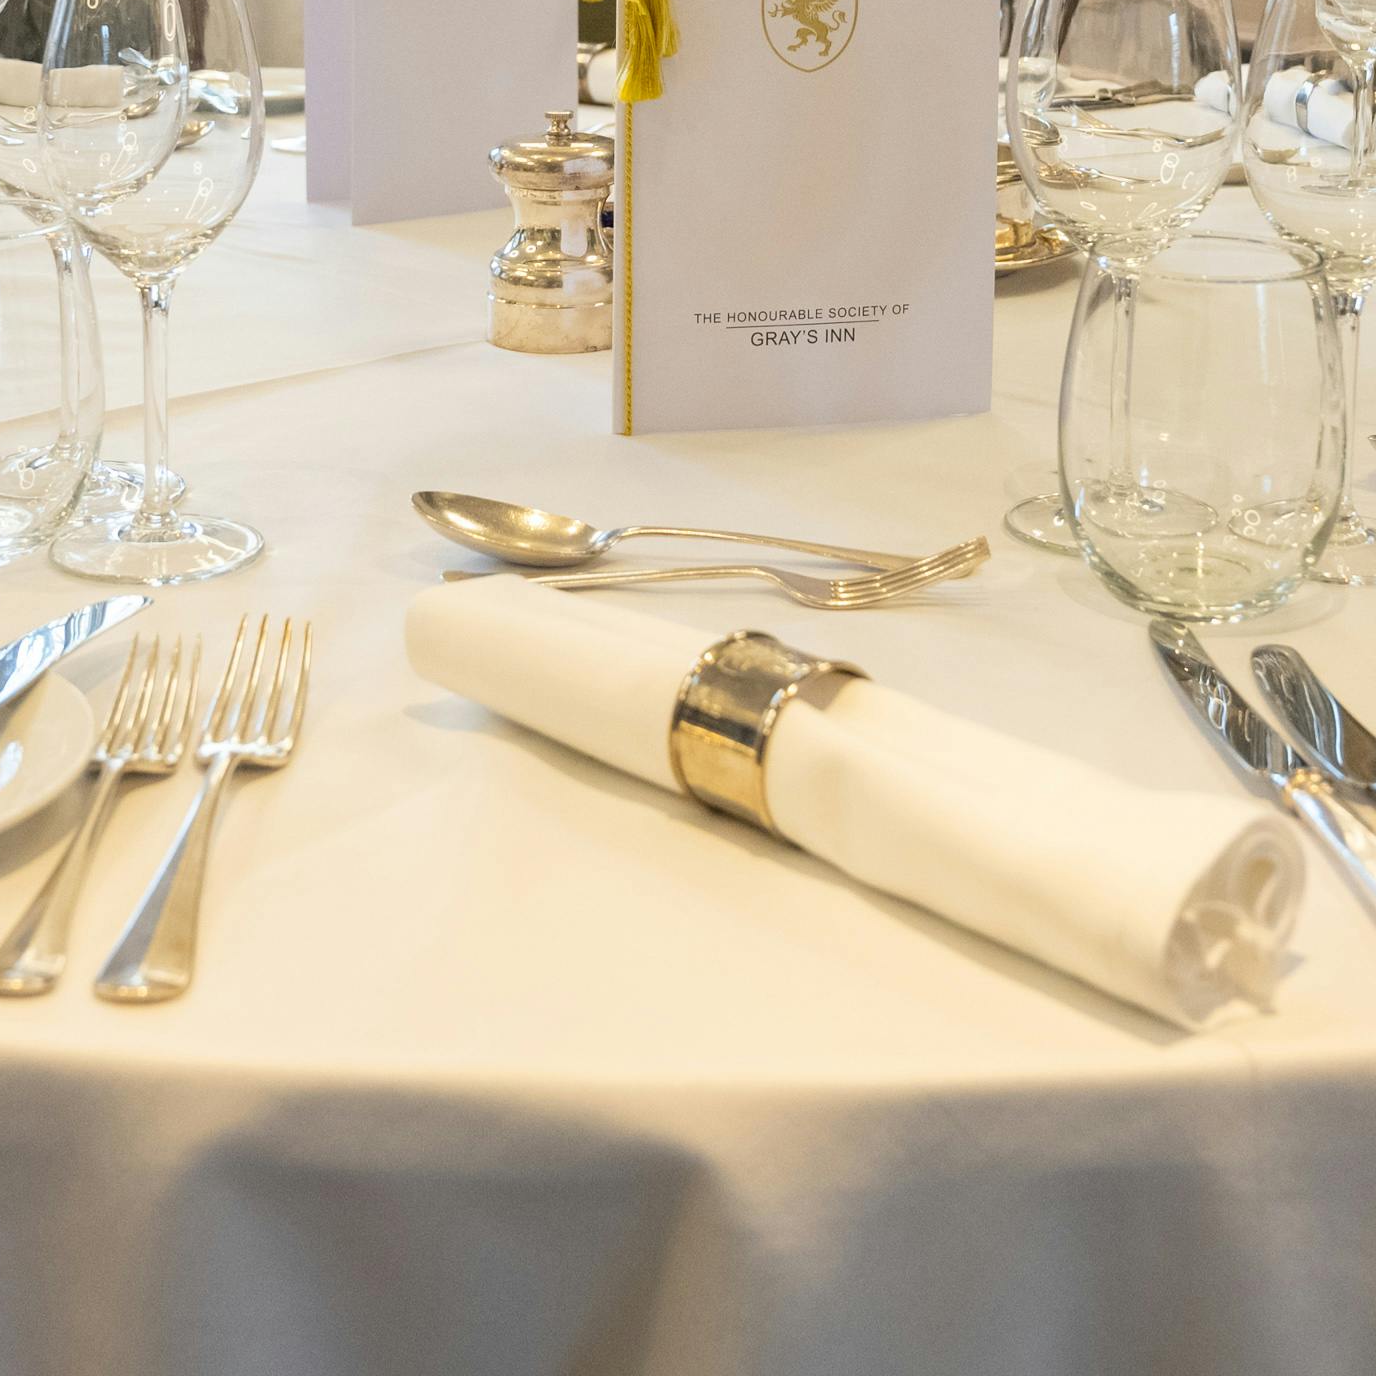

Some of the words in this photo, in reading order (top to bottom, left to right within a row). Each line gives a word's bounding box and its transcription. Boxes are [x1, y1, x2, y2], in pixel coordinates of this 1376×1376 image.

[694, 312, 722, 324] THE
[727, 308, 824, 323] HONOURABLE
[828, 304, 888, 319] SOCIETY
[892, 303, 910, 315] OF
[750, 329, 819, 347] GRAY'S
[825, 327, 856, 344] INN
